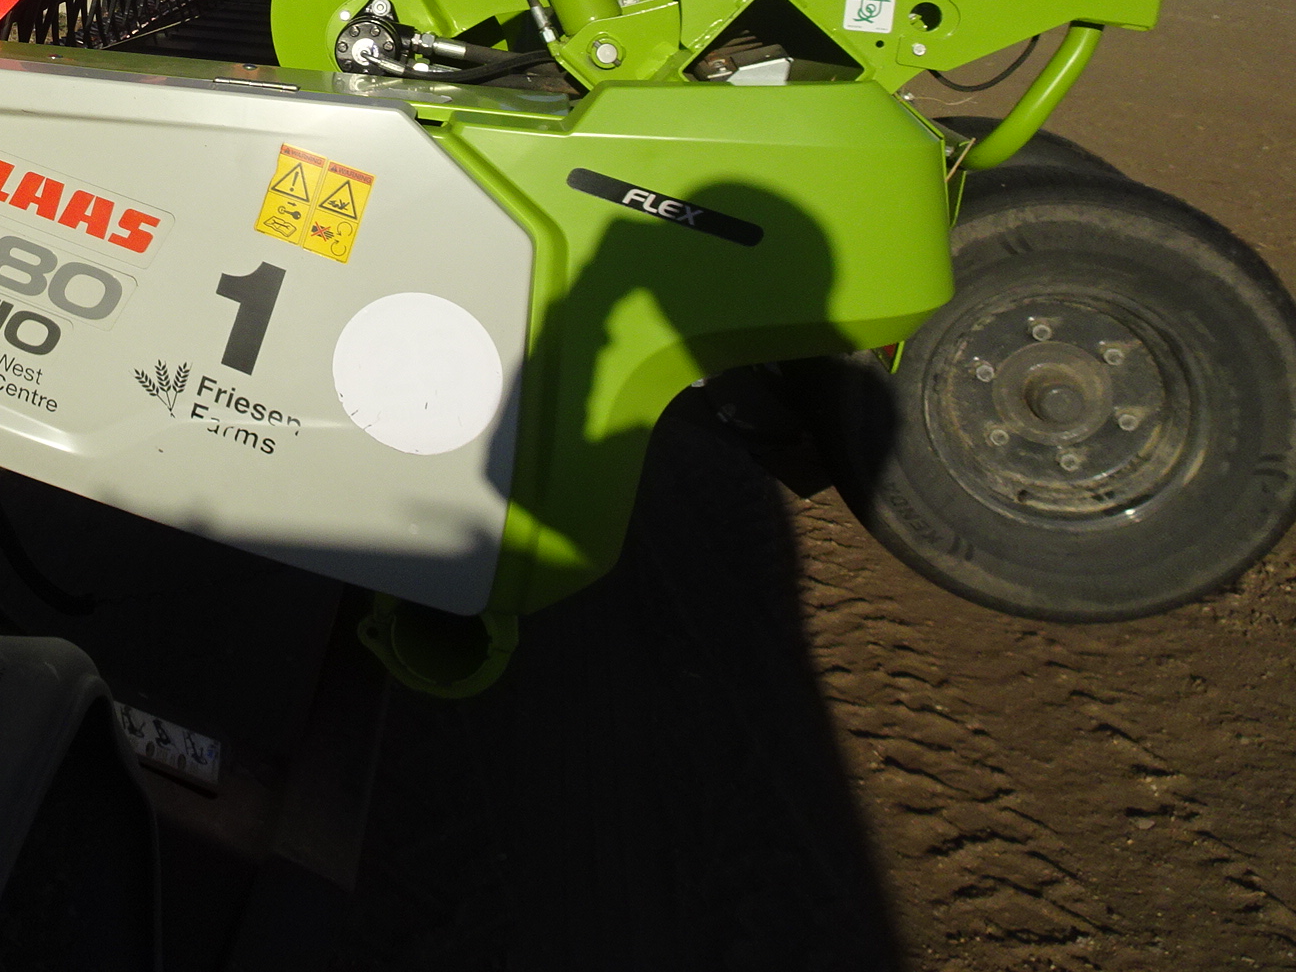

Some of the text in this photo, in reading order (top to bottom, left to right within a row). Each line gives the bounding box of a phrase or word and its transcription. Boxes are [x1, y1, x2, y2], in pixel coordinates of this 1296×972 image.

[290, 149, 323, 166] WARNING
[337, 167, 373, 184] WARNING
[622, 188, 704, 226] FLEX
[215, 261, 286, 376] 1
[190, 402, 277, 455] Farms
